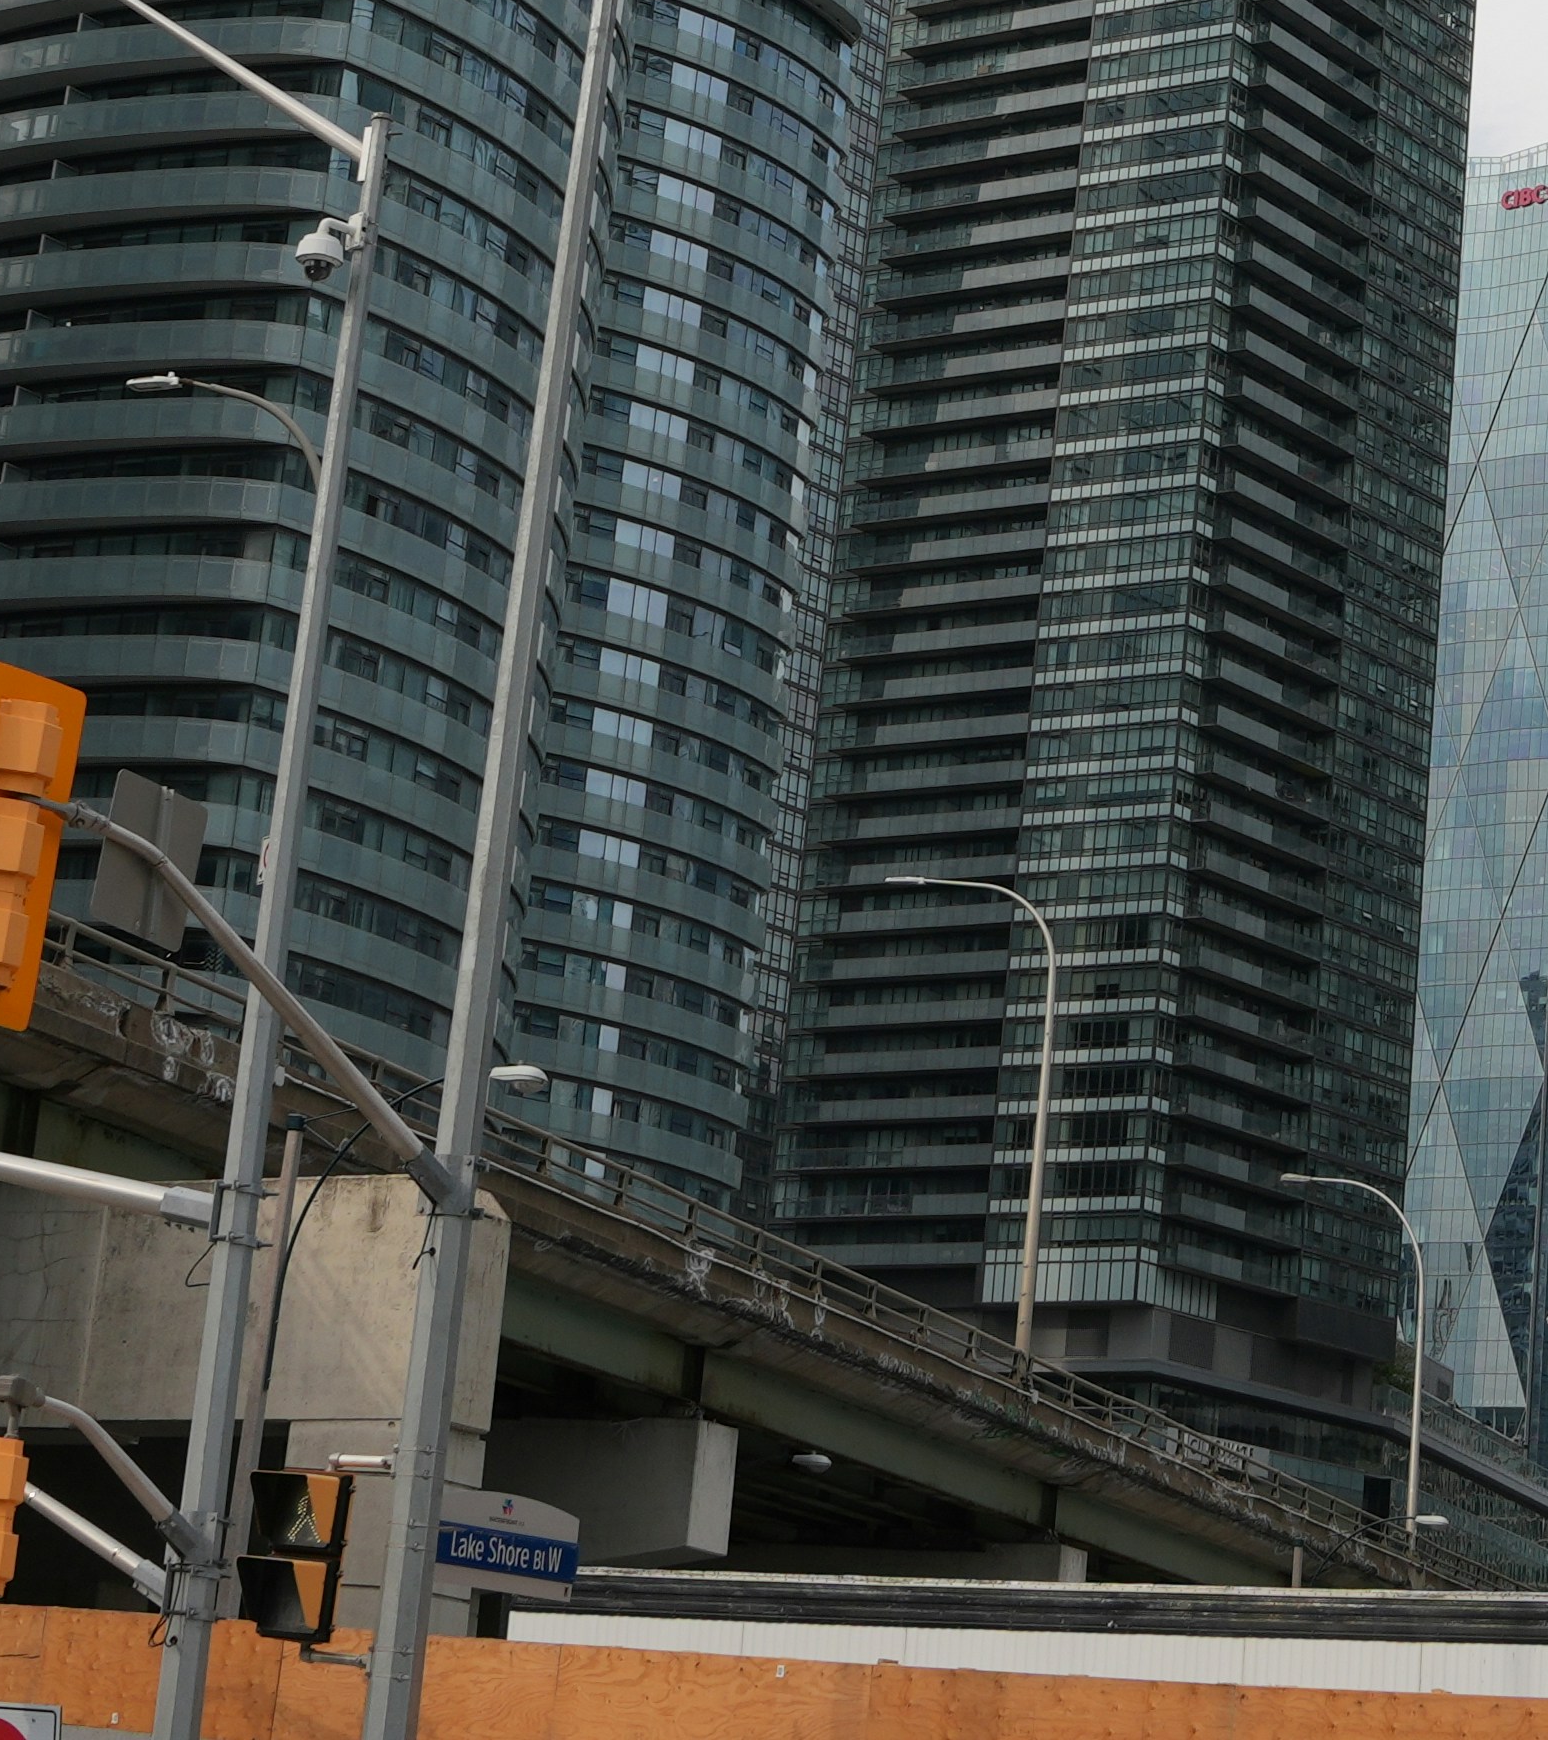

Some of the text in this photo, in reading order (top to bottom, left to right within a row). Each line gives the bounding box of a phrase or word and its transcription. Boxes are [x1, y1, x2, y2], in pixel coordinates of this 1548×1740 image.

[1501, 184, 1548, 210] CIBC
[450, 1531, 563, 1573] Lake Shore Bl W
